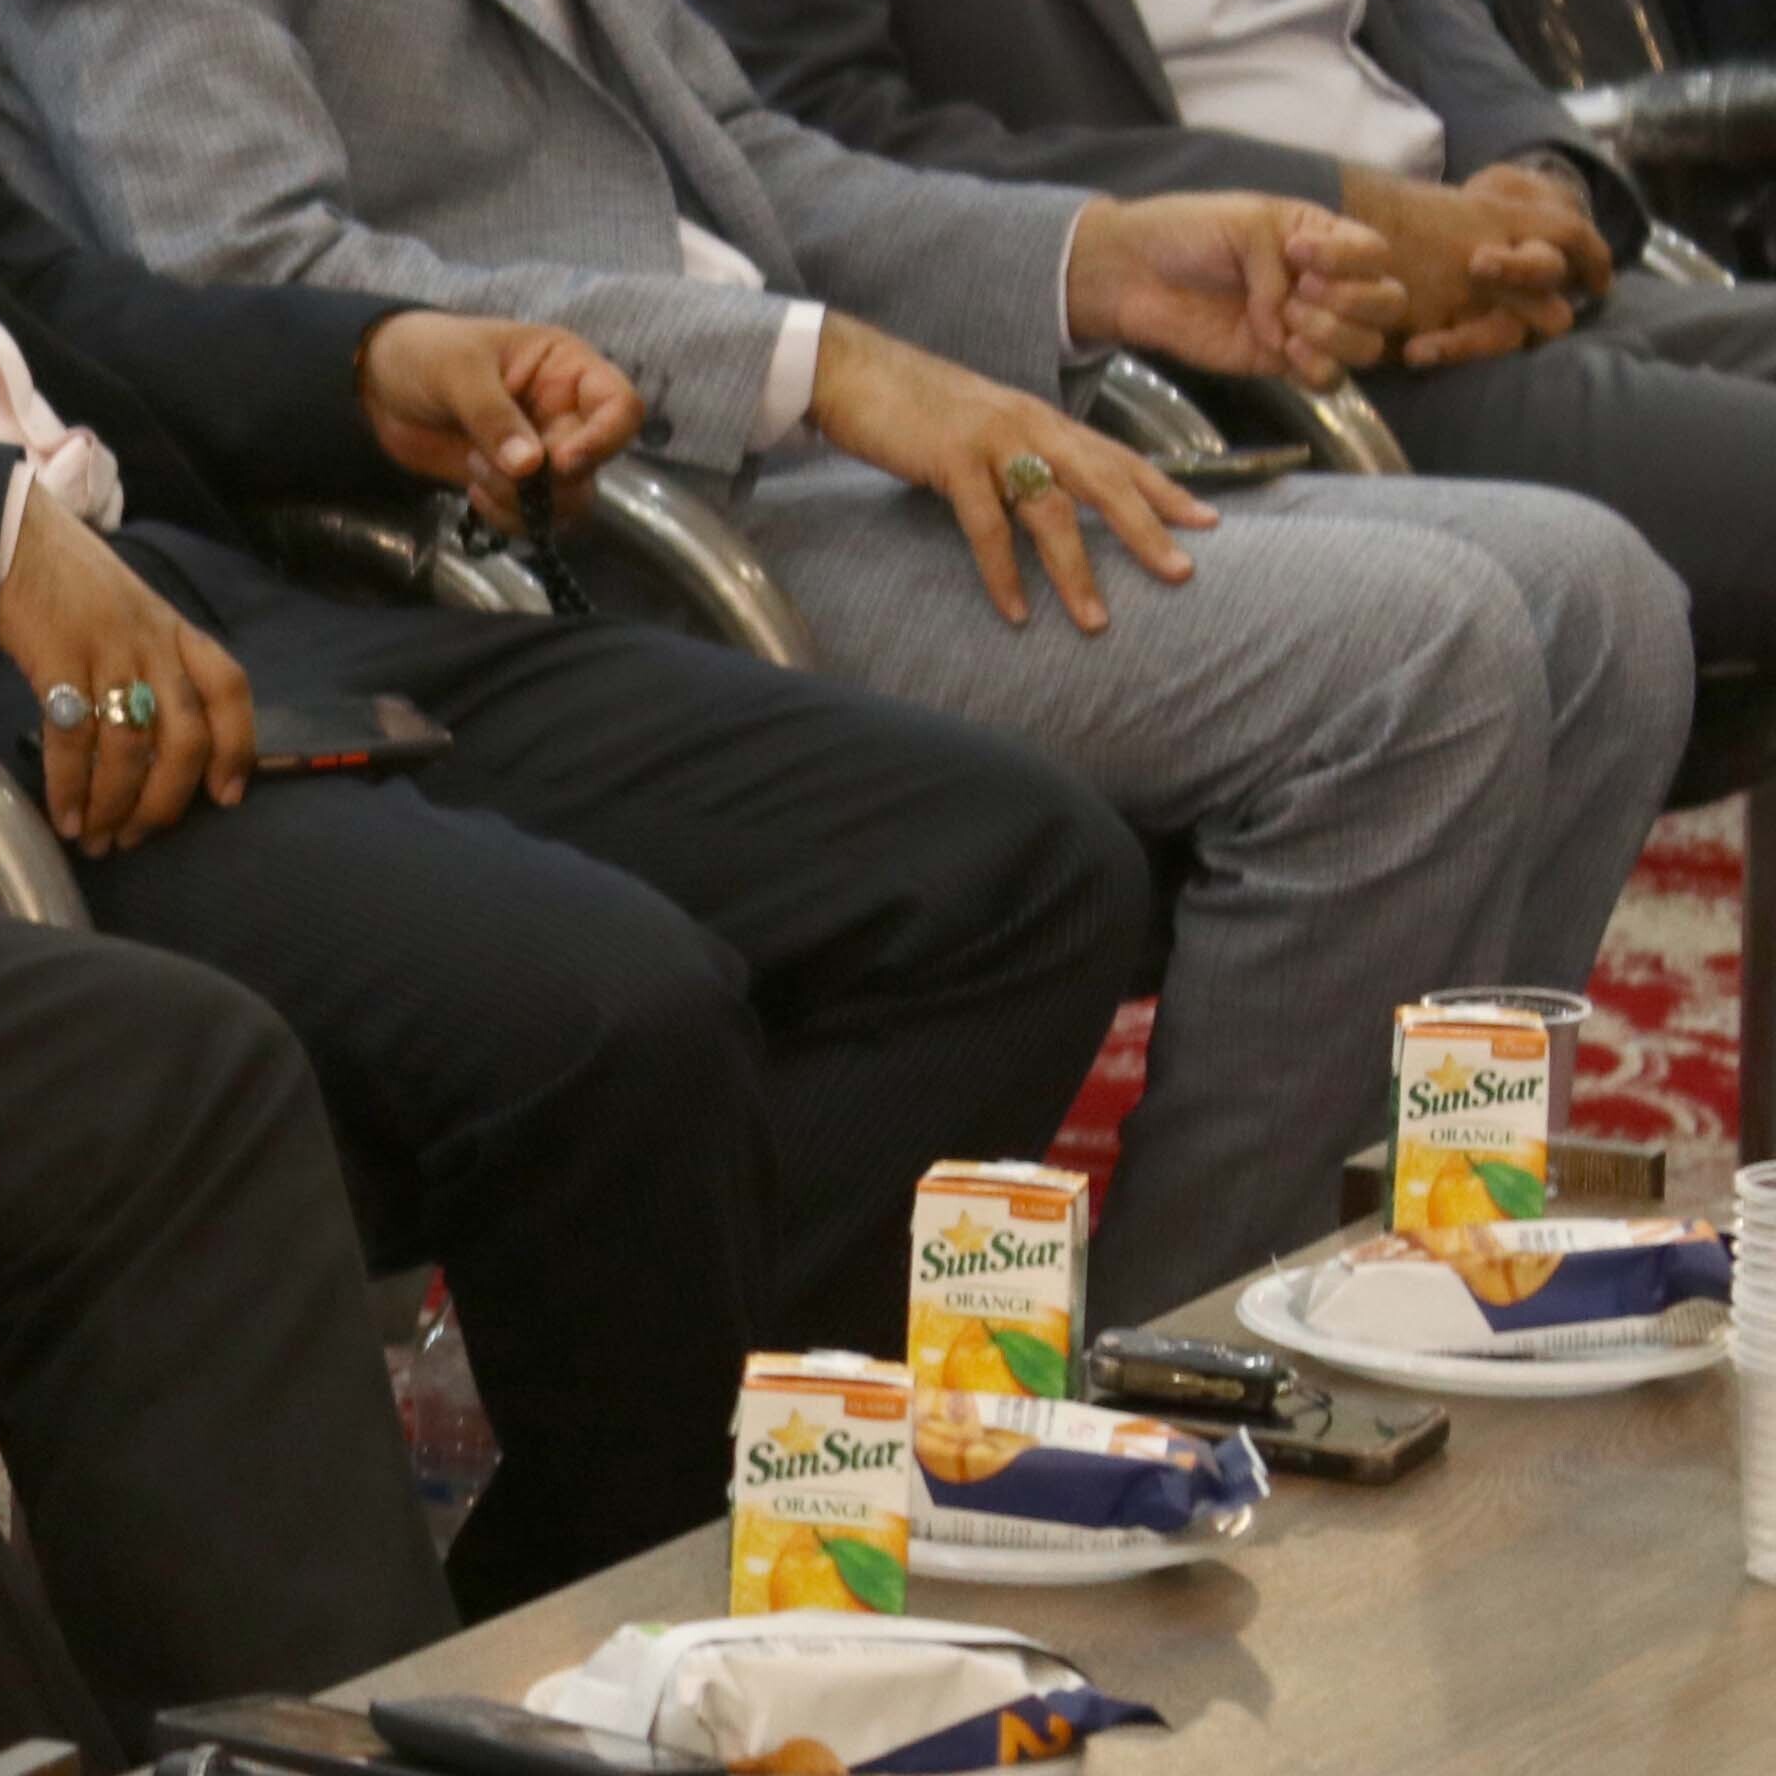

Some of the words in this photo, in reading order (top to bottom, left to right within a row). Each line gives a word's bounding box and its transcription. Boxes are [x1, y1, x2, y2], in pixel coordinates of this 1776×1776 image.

[1407, 1070, 1543, 1120] SunStar
[1430, 1126, 1516, 1145] ORANGE
[920, 1229, 1065, 1283] SunStar
[945, 1292, 1035, 1314] ORANGE
[745, 1428, 906, 1487] SunStar
[771, 1494, 870, 1520] ORANGE
